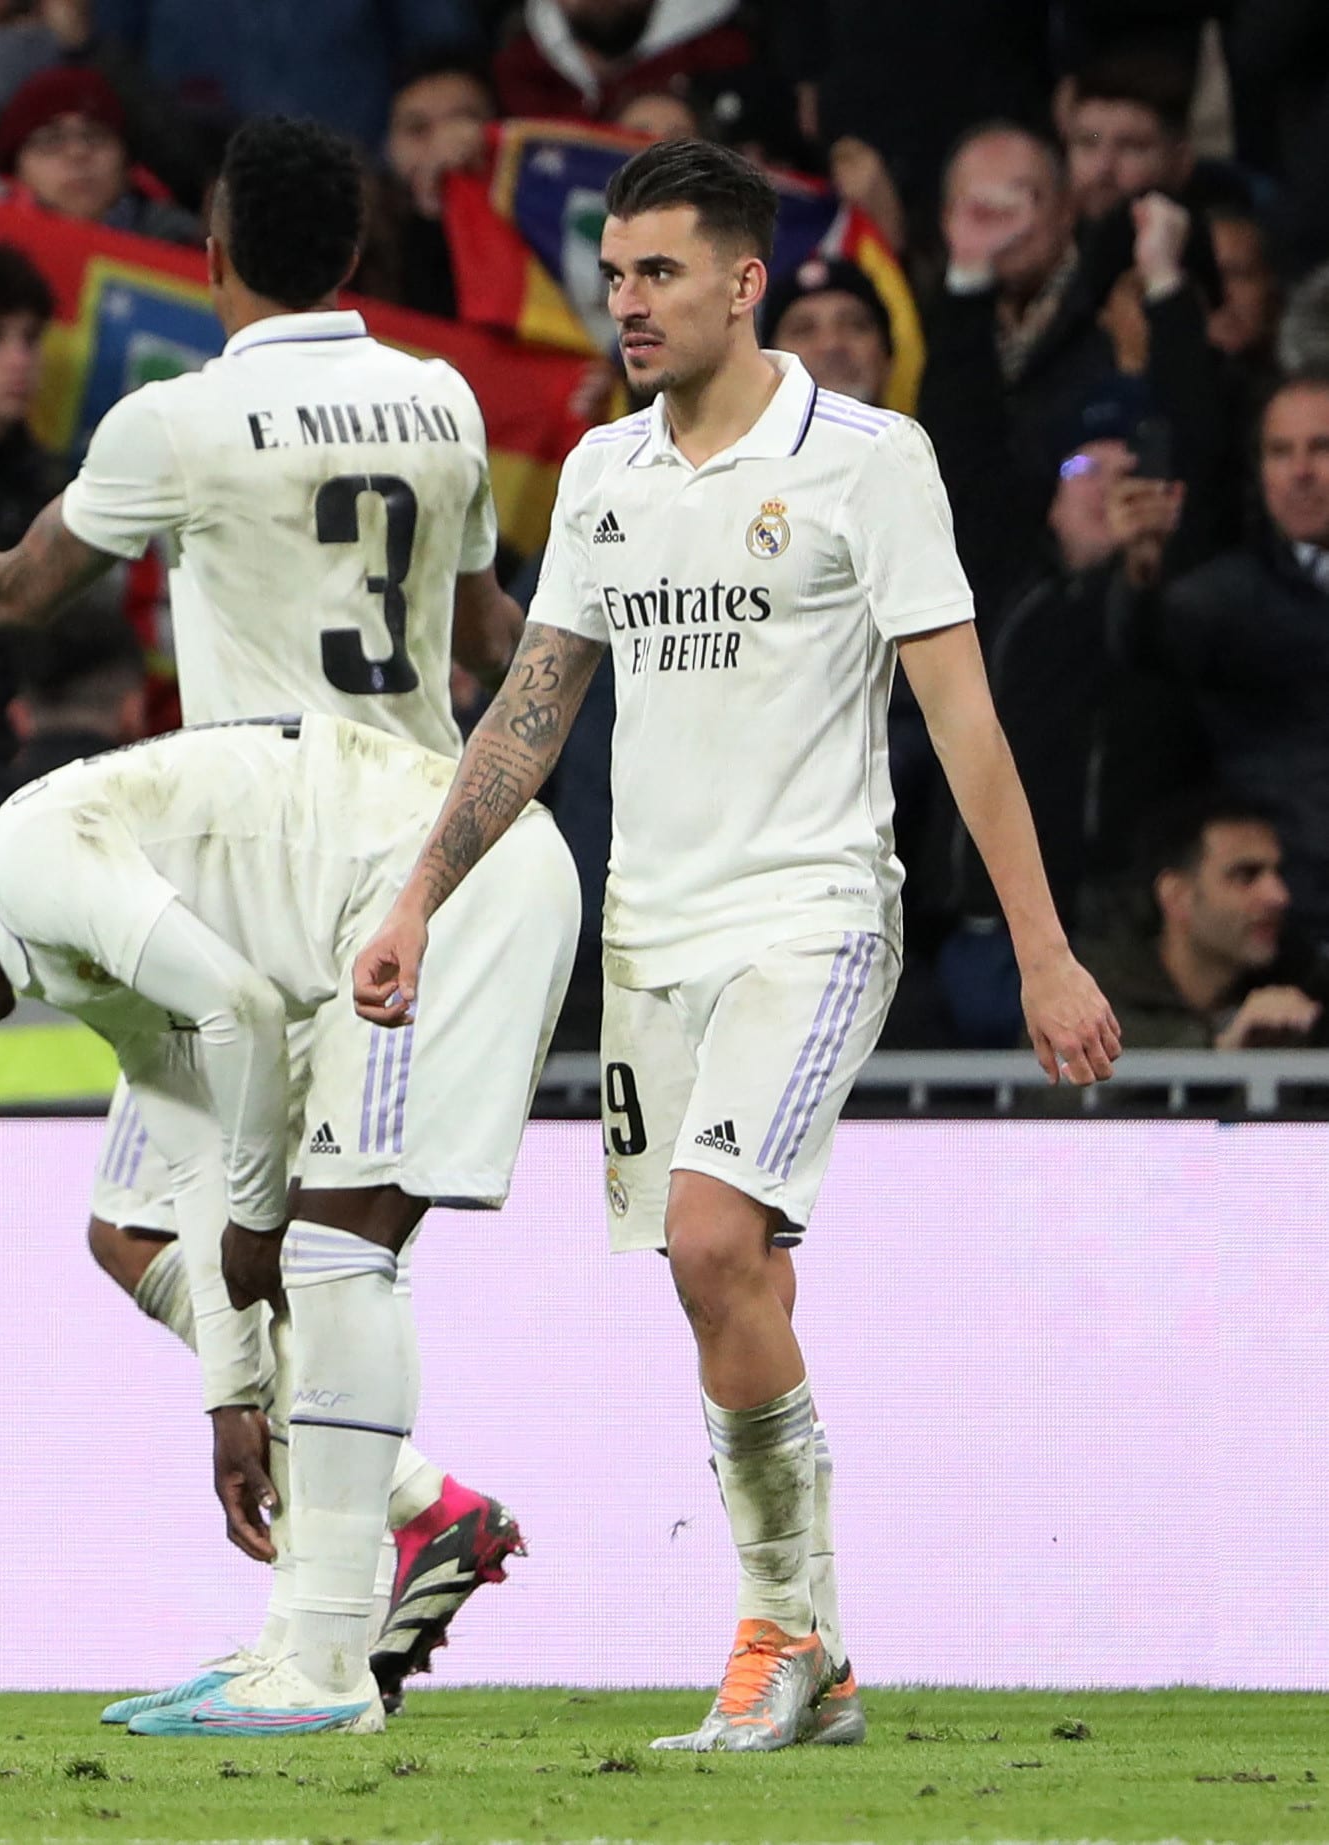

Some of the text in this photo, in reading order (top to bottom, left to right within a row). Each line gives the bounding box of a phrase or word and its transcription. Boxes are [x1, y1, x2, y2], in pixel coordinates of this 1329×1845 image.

[246, 411, 290, 450] E.
[592, 531, 626, 544] adidas
[315, 473, 419, 695] 3
[603, 576, 771, 630] Emirates
[658, 632, 741, 672] BETTER
[518, 656, 559, 692] 23
[694, 1134, 742, 1157] adidas
